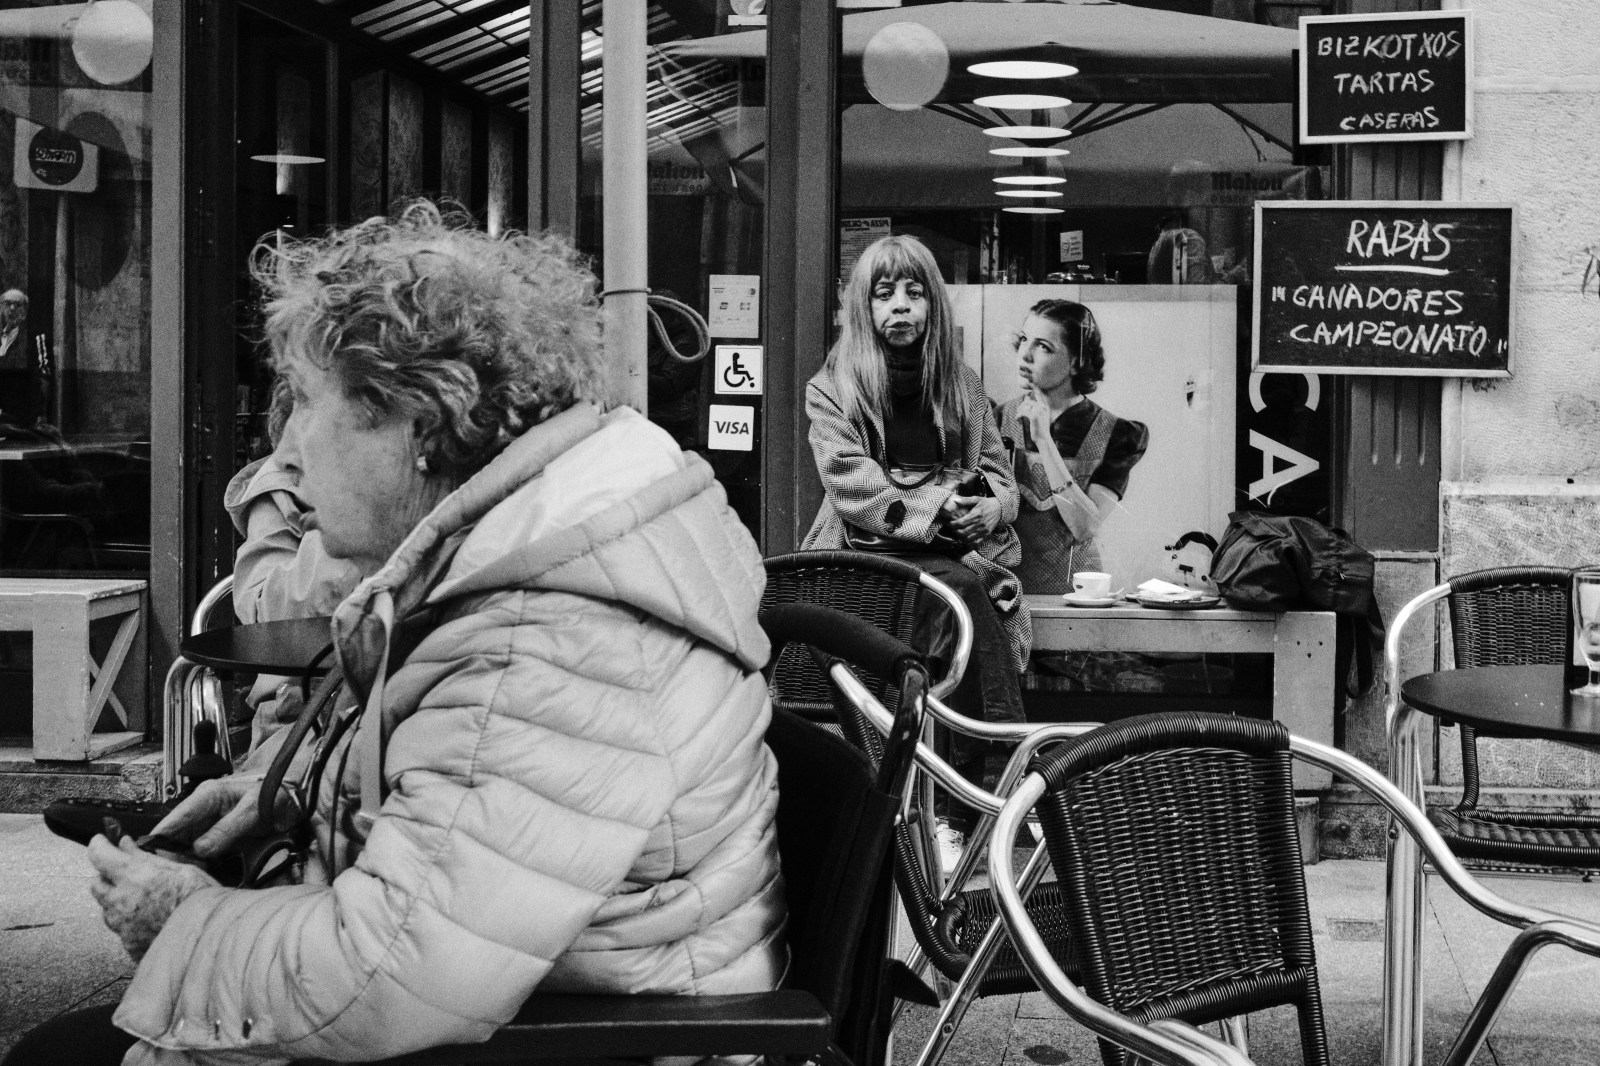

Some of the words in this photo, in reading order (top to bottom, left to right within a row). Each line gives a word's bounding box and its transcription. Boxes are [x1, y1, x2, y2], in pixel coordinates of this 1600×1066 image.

[1333, 69, 1435, 95] TARTAS
[1339, 106, 1440, 131] CASERAS
[1346, 219, 1454, 261] RABAS
[713, 420, 750, 435] VISA
